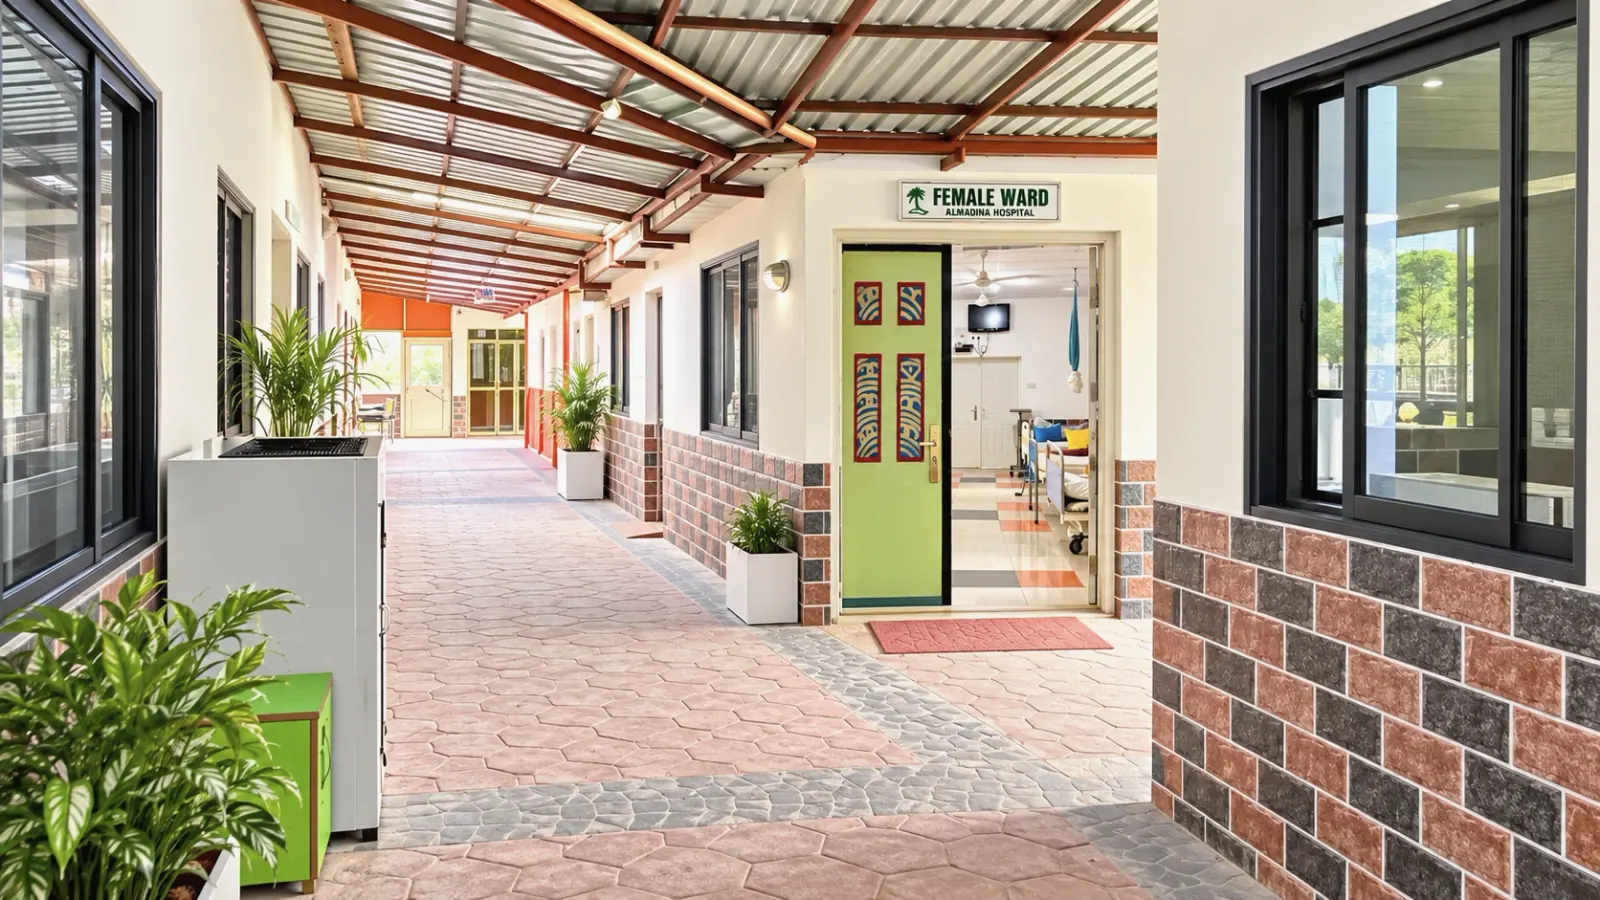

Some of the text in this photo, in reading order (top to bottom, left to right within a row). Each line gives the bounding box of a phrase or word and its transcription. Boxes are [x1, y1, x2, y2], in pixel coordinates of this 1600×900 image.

[933, 187, 1049, 207] FEMALE WARD
[945, 208, 1035, 217] ALMADINA HOSPITAL
